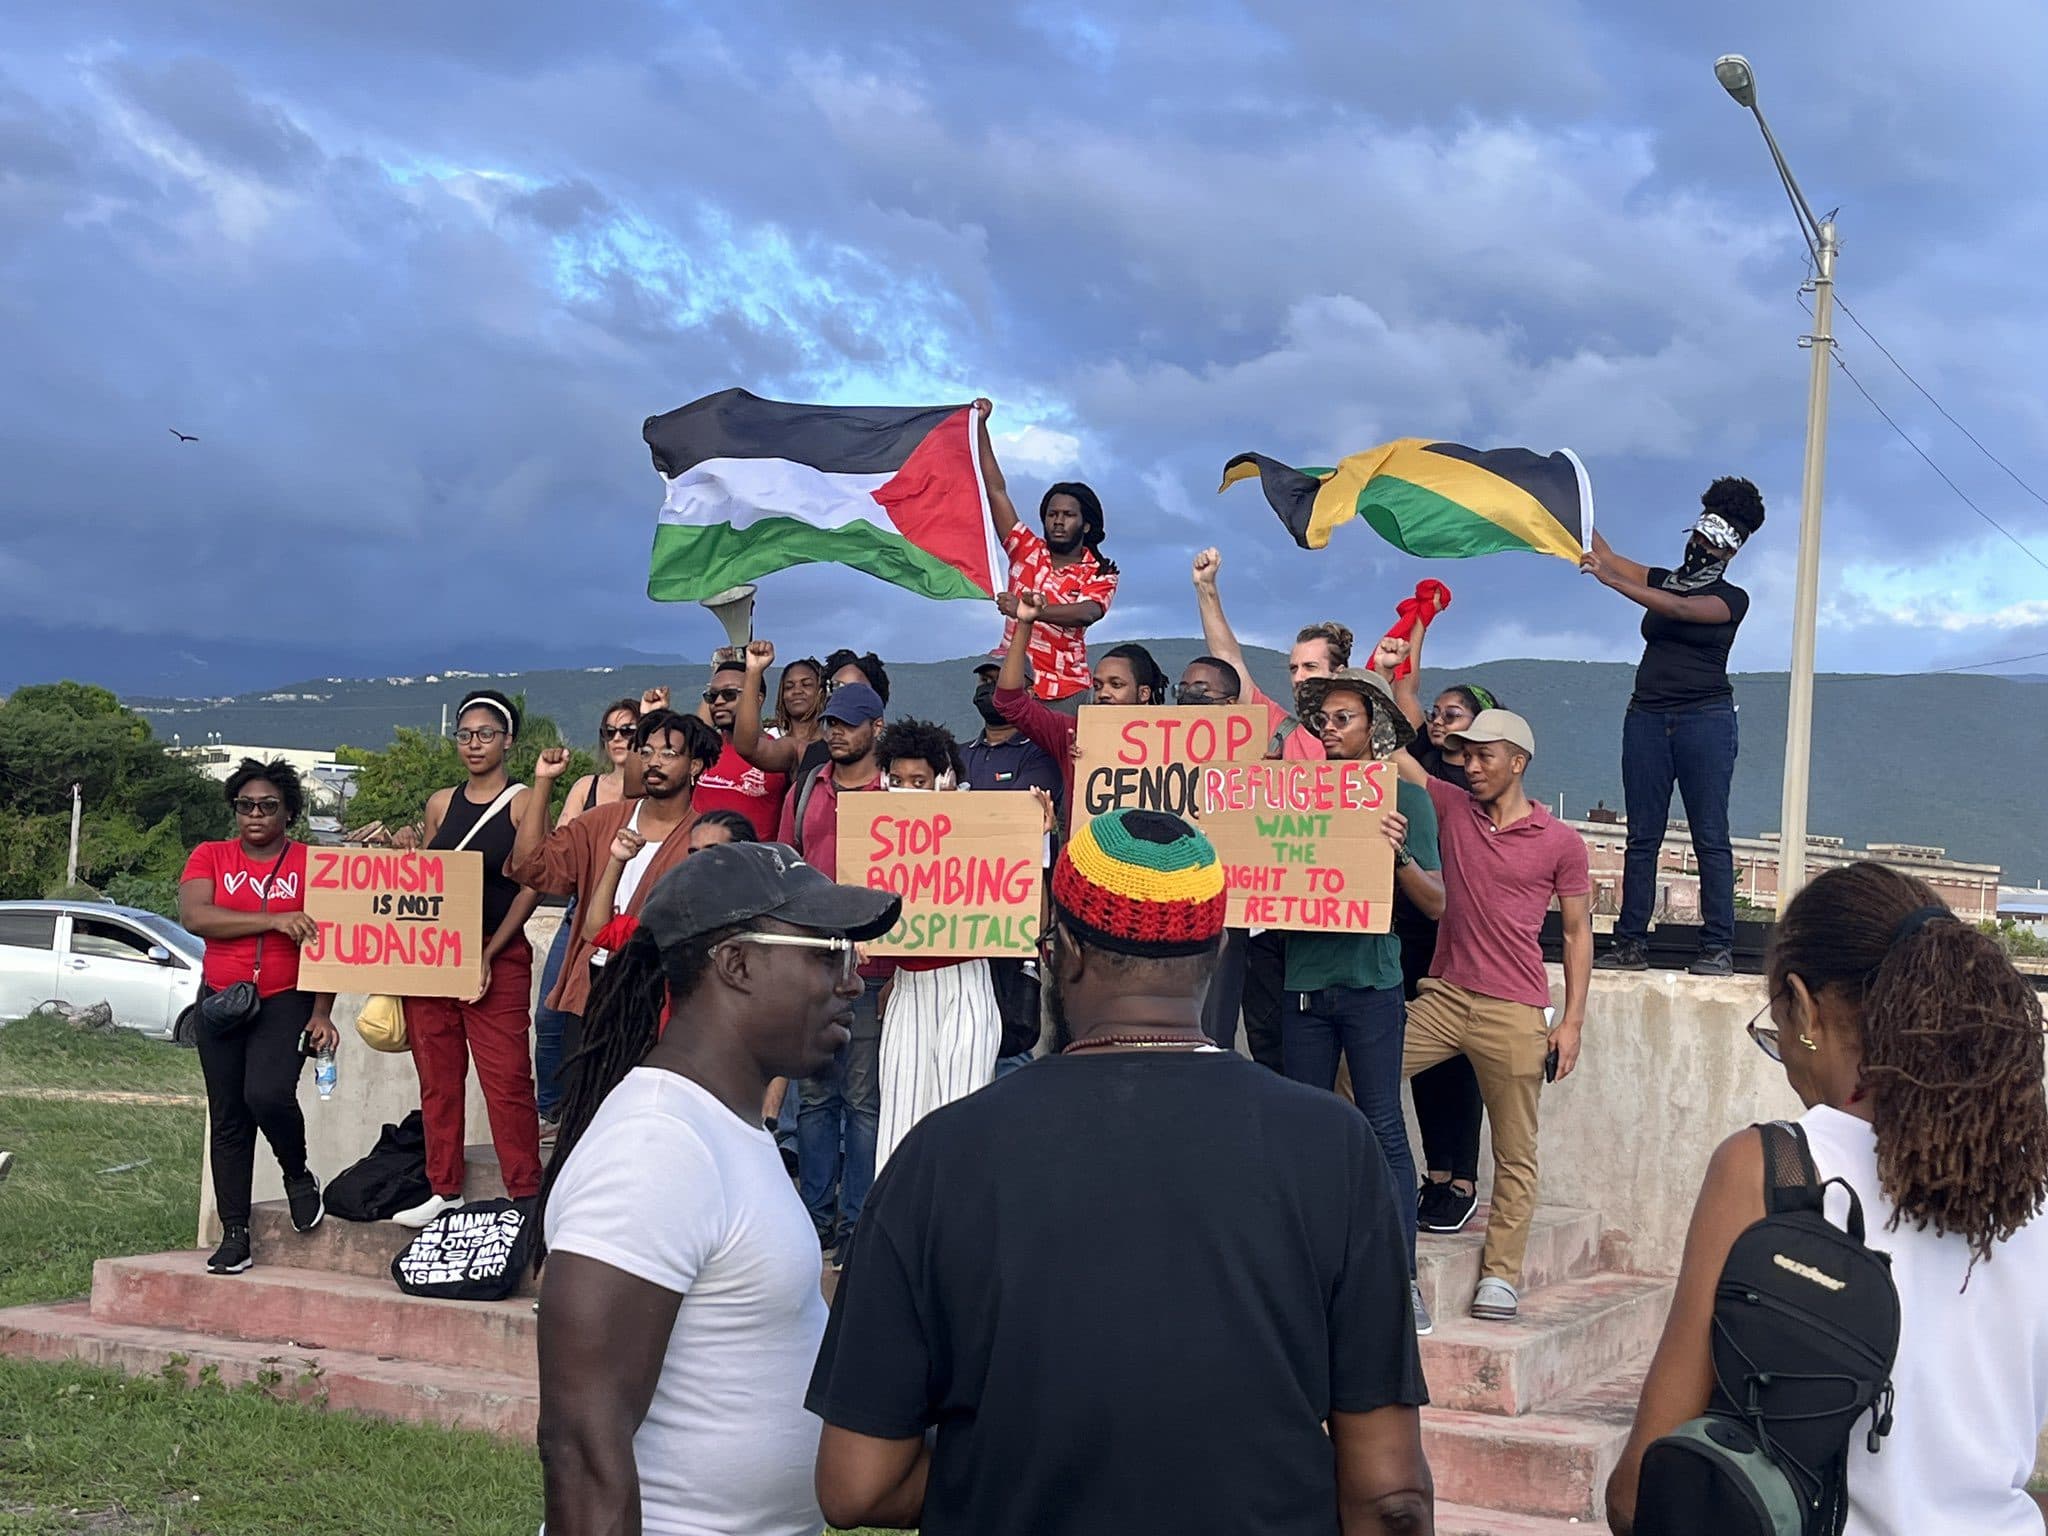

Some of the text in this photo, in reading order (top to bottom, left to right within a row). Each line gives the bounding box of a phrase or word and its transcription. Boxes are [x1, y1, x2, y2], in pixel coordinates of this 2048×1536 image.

[1119, 716, 1251, 764] STOP
[1206, 763, 1386, 813] REFUGEES
[870, 814, 951, 861] STOP
[1256, 815, 1332, 837] WANT
[1272, 843, 1316, 863] THE
[311, 854, 444, 893] ZIONISM
[867, 857, 1034, 905] BOMBING
[1306, 869, 1344, 893] TO
[373, 895, 444, 916] IS NOT
[1245, 896, 1369, 928] RETURN
[305, 922, 461, 967] JUDAISM
[867, 913, 1037, 951] OSPITALS
